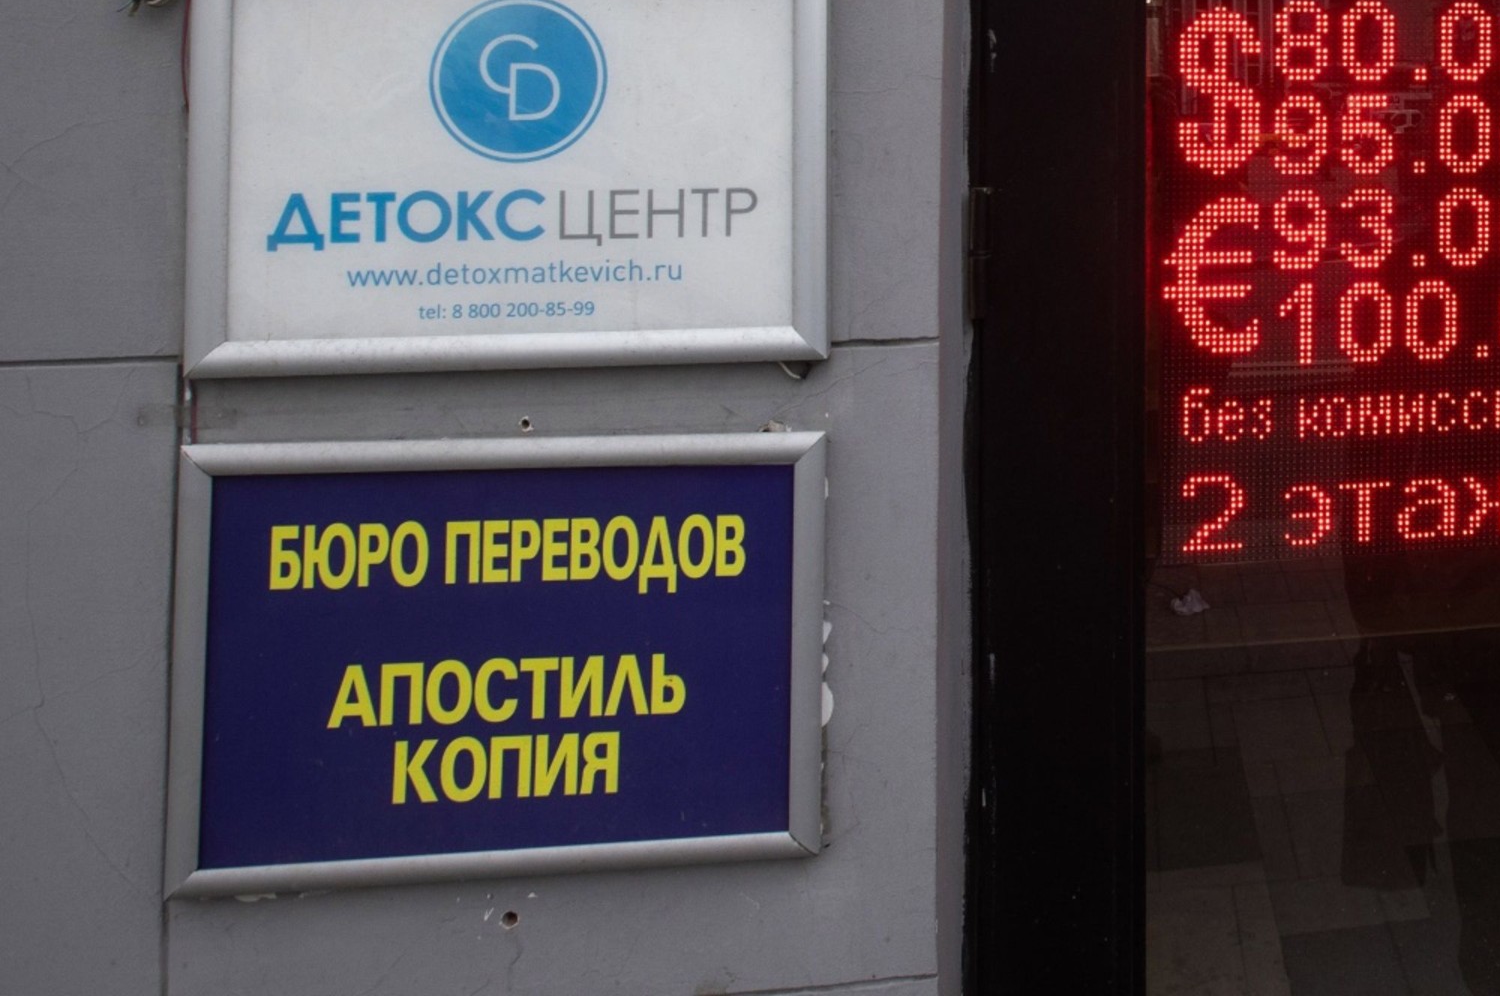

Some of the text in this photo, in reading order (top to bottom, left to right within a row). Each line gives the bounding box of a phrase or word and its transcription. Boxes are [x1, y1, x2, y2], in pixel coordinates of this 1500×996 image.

[346, 259, 684, 289] www.detoxmatkevich.ru
[418, 300, 596, 321] tel: 8 800 200-85-99
[1182, 388, 1272, 443] без
[1182, 475, 1244, 552] 2
[268, 514, 747, 595] БЮРО ПЕРЕВОДОВ
[326, 653, 687, 729] АПОСТИЛЬ
[391, 731, 620, 805] КОПИЯ
